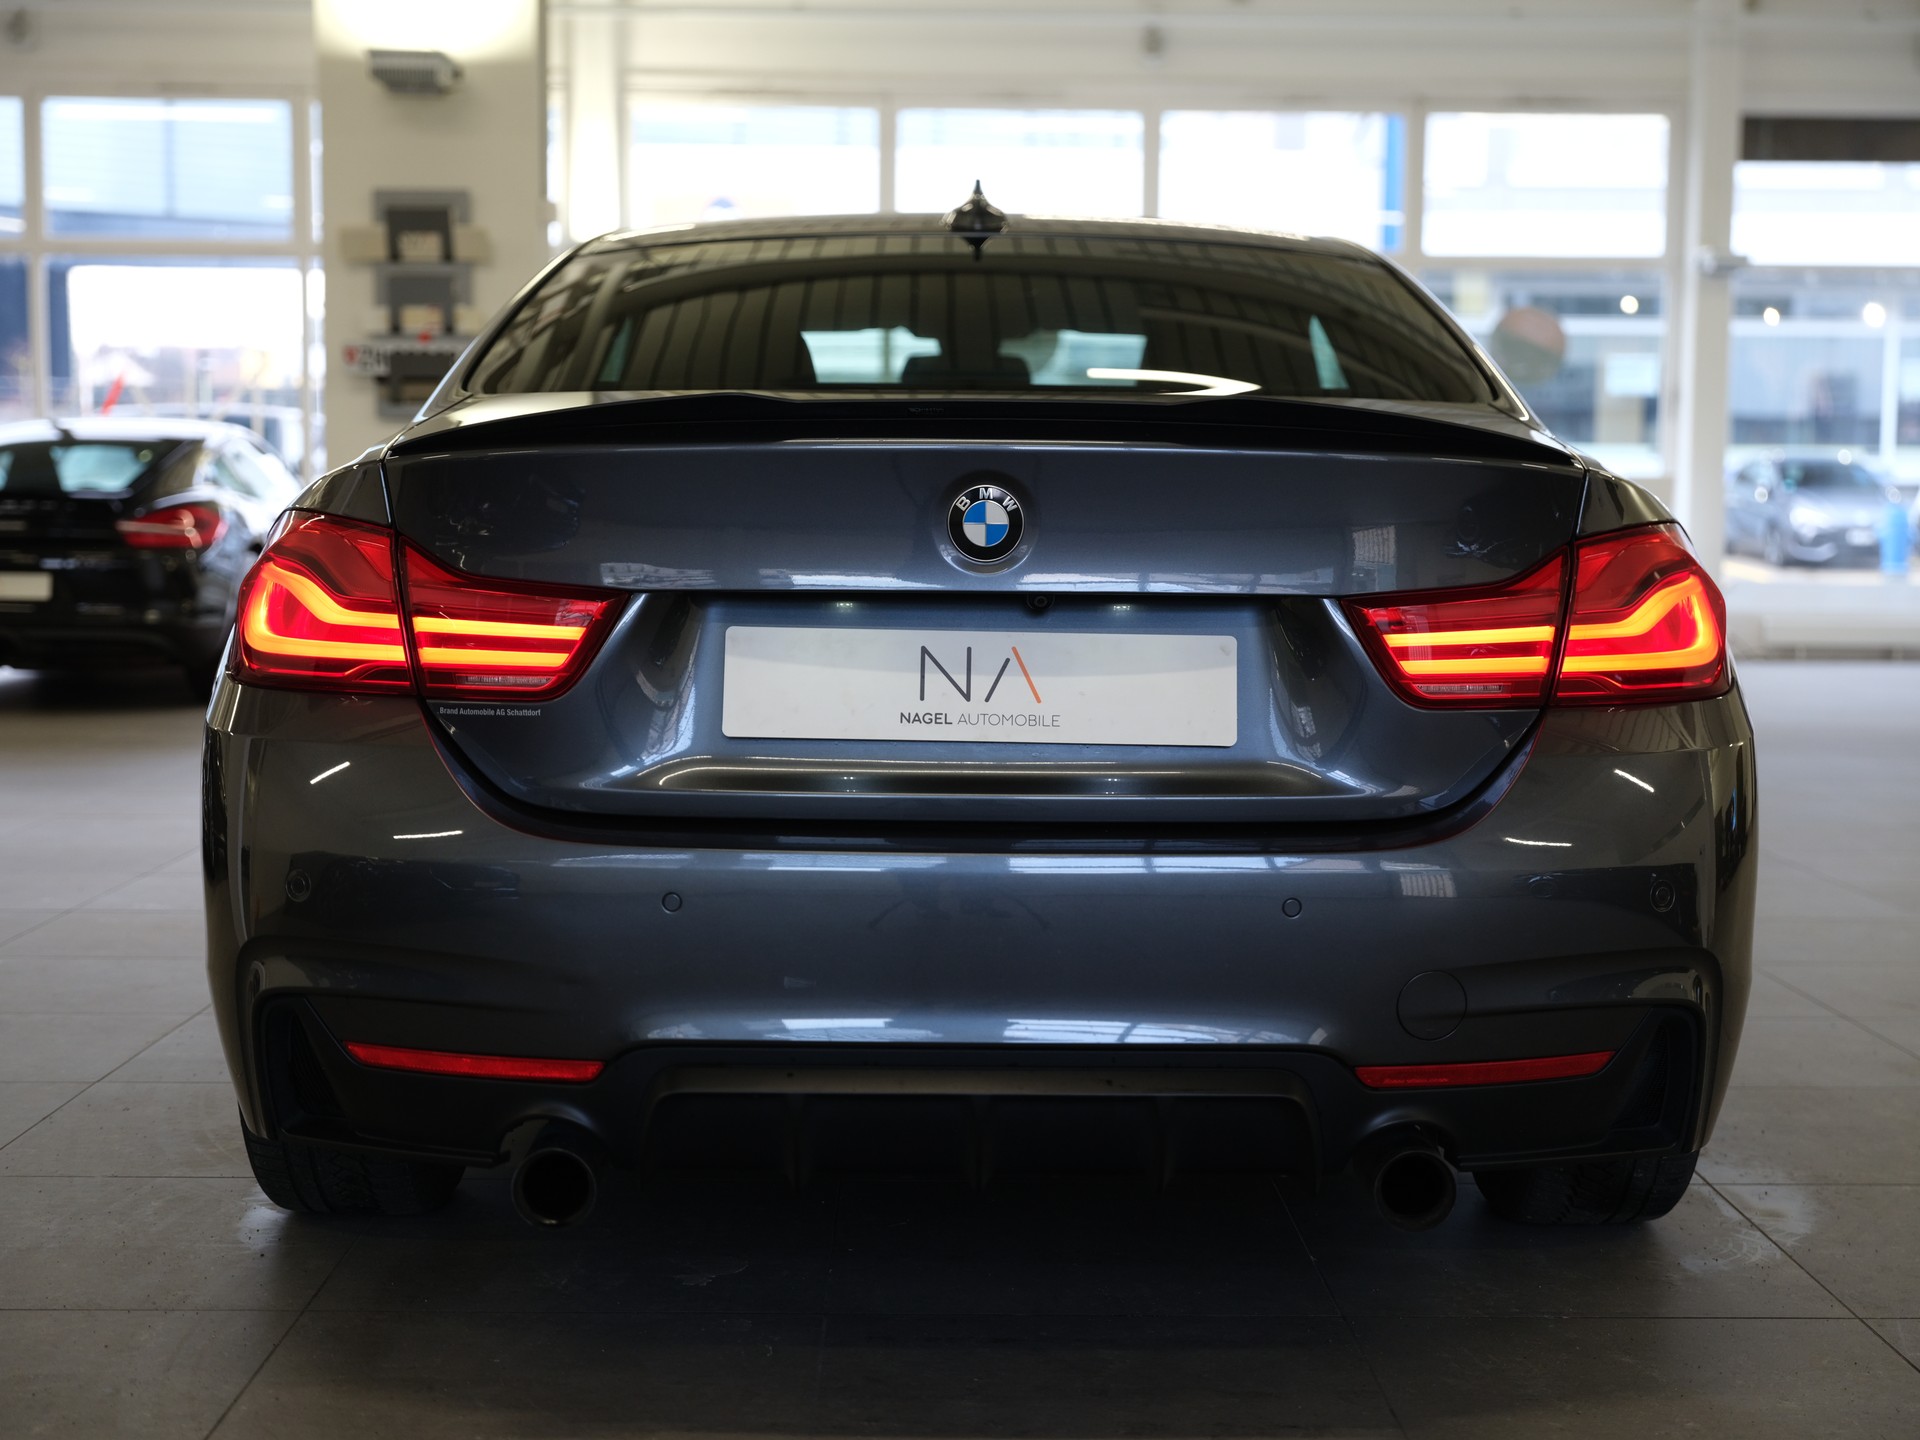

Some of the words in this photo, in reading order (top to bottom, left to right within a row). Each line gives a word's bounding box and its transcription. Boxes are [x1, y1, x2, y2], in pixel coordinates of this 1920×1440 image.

[956, 488, 1017, 511] BMW
[920, 646, 1041, 703] NA
[439, 707, 458, 715] Brand
[459, 708, 495, 716] Automobile
[506, 709, 541, 717] Schattdorf
[900, 712, 953, 725] NAGEL
[957, 713, 1061, 728] AUTOMOBILE
